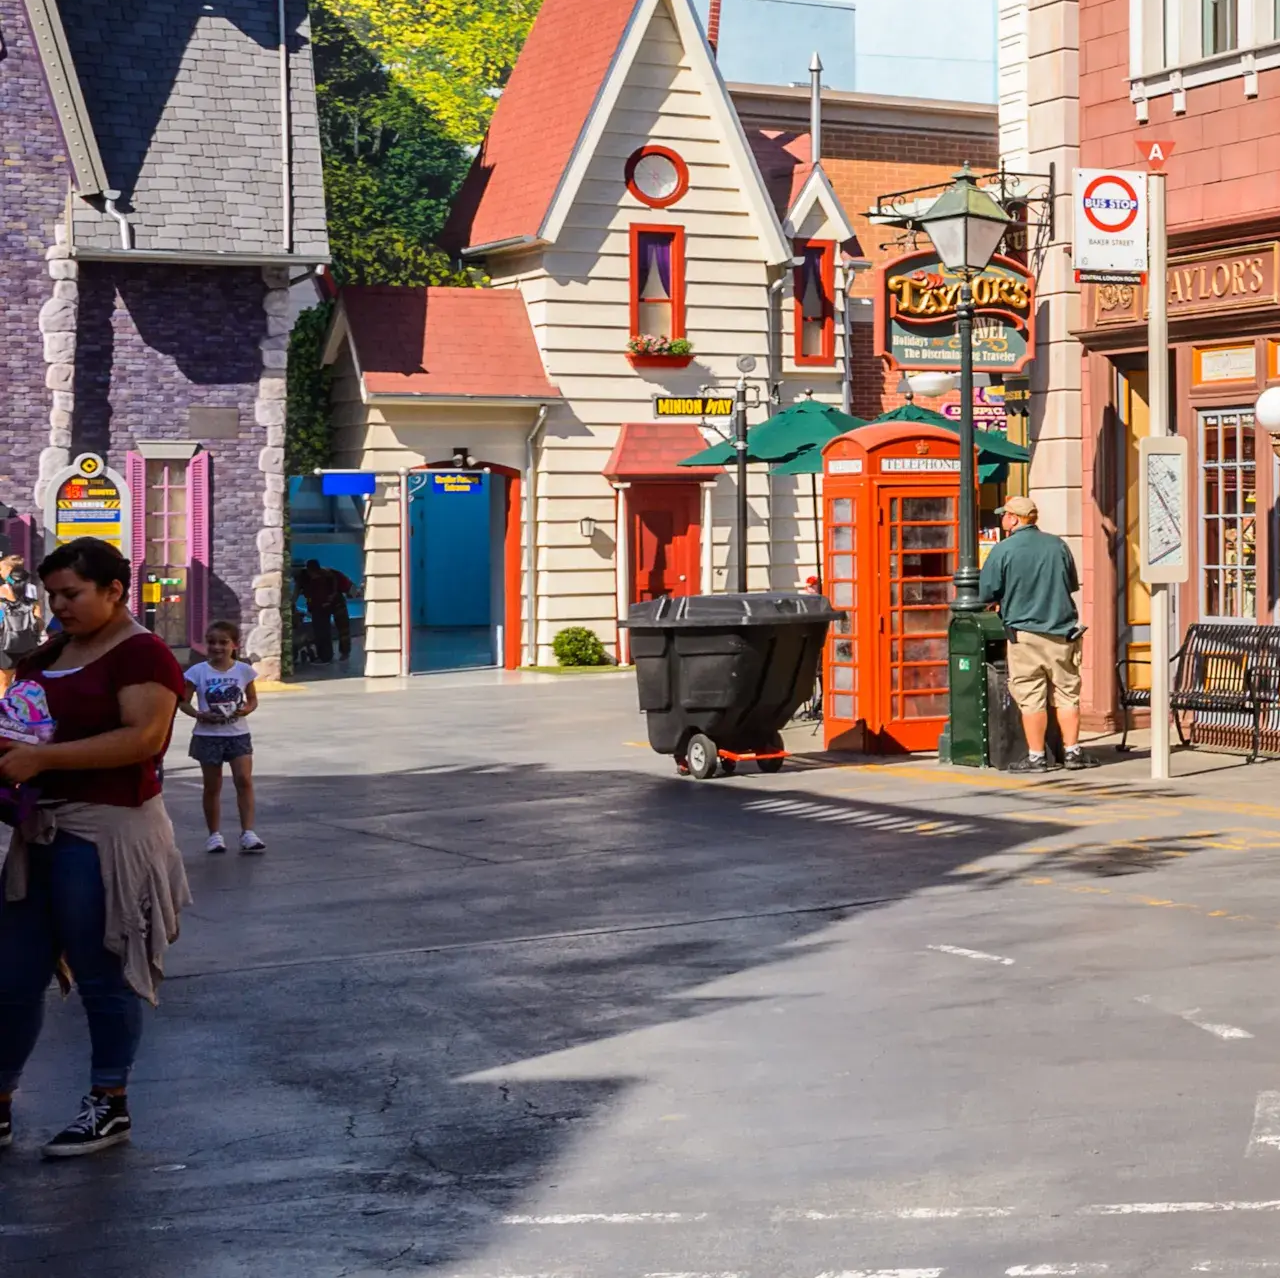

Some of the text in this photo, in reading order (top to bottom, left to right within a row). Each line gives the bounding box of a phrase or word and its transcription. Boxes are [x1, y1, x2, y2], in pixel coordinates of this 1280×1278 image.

[1148, 143, 1164, 160] A
[1084, 198, 1138, 210] BUS STOP
[1167, 257, 1264, 304] AYLOR'S
[953, 318, 1007, 345] TAVEL
[892, 335, 928, 347] Holidays
[904, 348, 1016, 362] The Discriminng Traveler
[658, 398, 732, 414] MINION WAY
[886, 459, 960, 470] TELEPHONE
